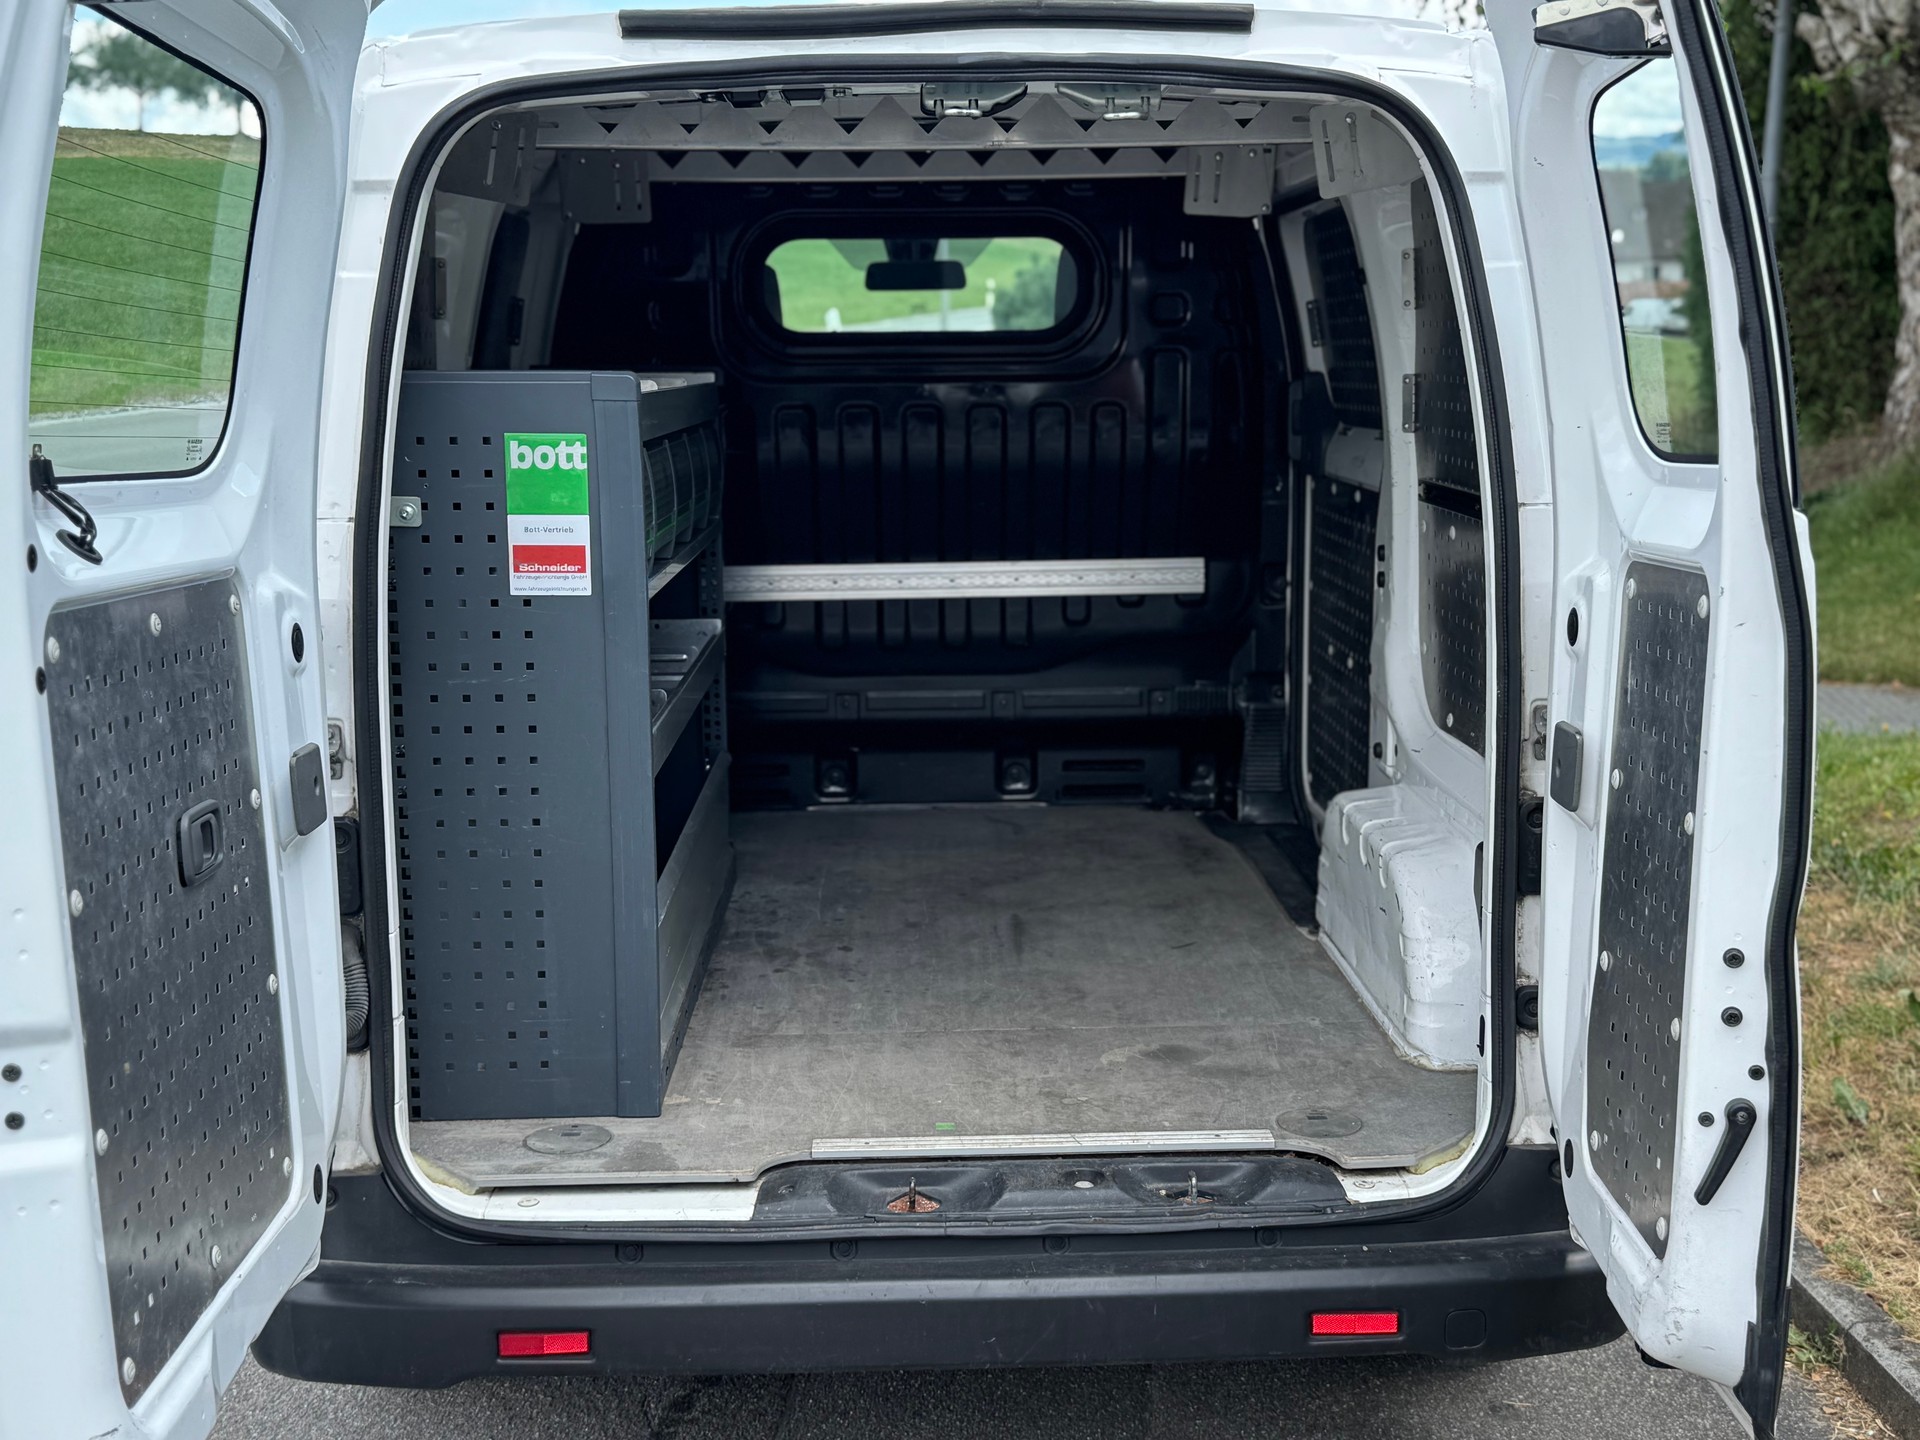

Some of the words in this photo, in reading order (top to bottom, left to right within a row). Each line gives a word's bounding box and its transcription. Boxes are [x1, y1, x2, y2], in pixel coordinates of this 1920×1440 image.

[509, 440, 587, 470] bott
[524, 526, 574, 534] Bott-Vertrieb
[518, 562, 582, 572] Schneider
